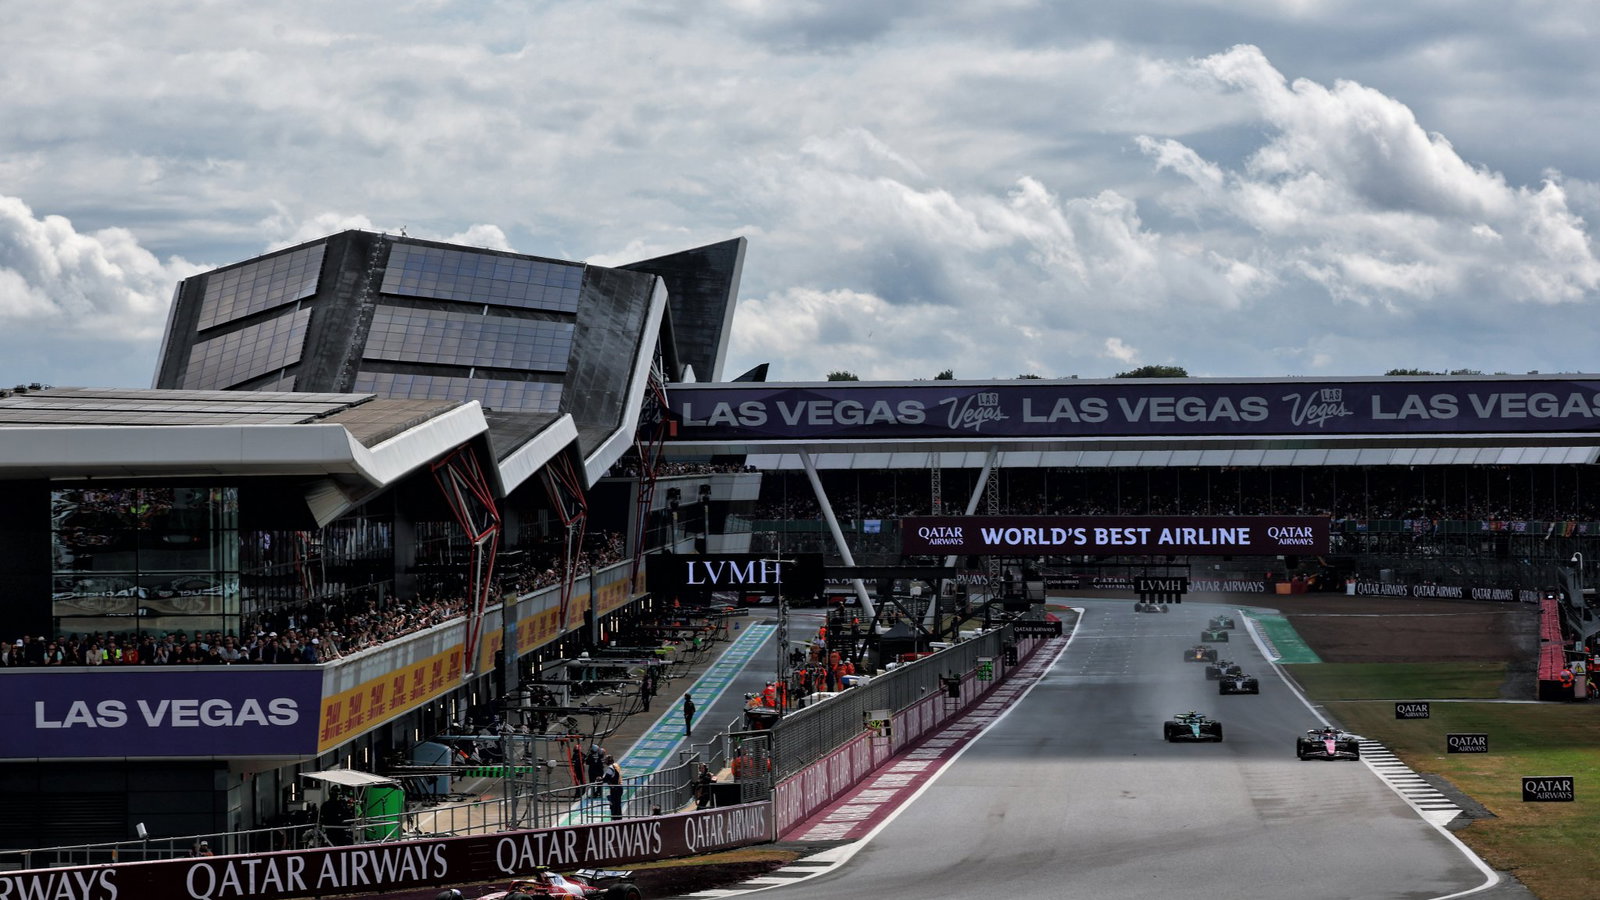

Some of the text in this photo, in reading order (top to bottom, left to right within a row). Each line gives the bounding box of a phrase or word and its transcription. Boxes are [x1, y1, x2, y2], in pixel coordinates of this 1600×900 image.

[980, 393, 998, 406] LAS
[1322, 389, 1341, 401] LAS
[683, 401, 767, 426] LAS
[776, 400, 926, 426] VEGAS
[939, 394, 1009, 431] Vegas
[1023, 397, 1268, 422] LAS VEGAS
[1282, 390, 1353, 428] Vegas
[1372, 394, 1458, 419] LAS
[918, 527, 963, 540] QATAR
[981, 528, 1250, 545] WORLD'S BEST AIRLINE
[1267, 527, 1313, 539] QATAR
[686, 561, 783, 584] LVMH
[1141, 580, 1181, 591] LVMH
[1222, 581, 1265, 592] AIRWAYS
[1357, 583, 1379, 595] QATAR
[1413, 585, 1435, 597] QATAR
[35, 700, 127, 728] LAS
[137, 698, 299, 727] VEGAS
[1397, 704, 1428, 713] QATAR
[1449, 737, 1486, 747] QATAR
[1525, 780, 1572, 793] QATAR
[1536, 791, 1573, 799] AIRWAYS
[684, 814, 725, 851] QATAR
[726, 805, 765, 843] AIRWAYS
[496, 821, 662, 874] QATAR AIRWAYS
[186, 843, 448, 900] QATAR AIRWAYS
